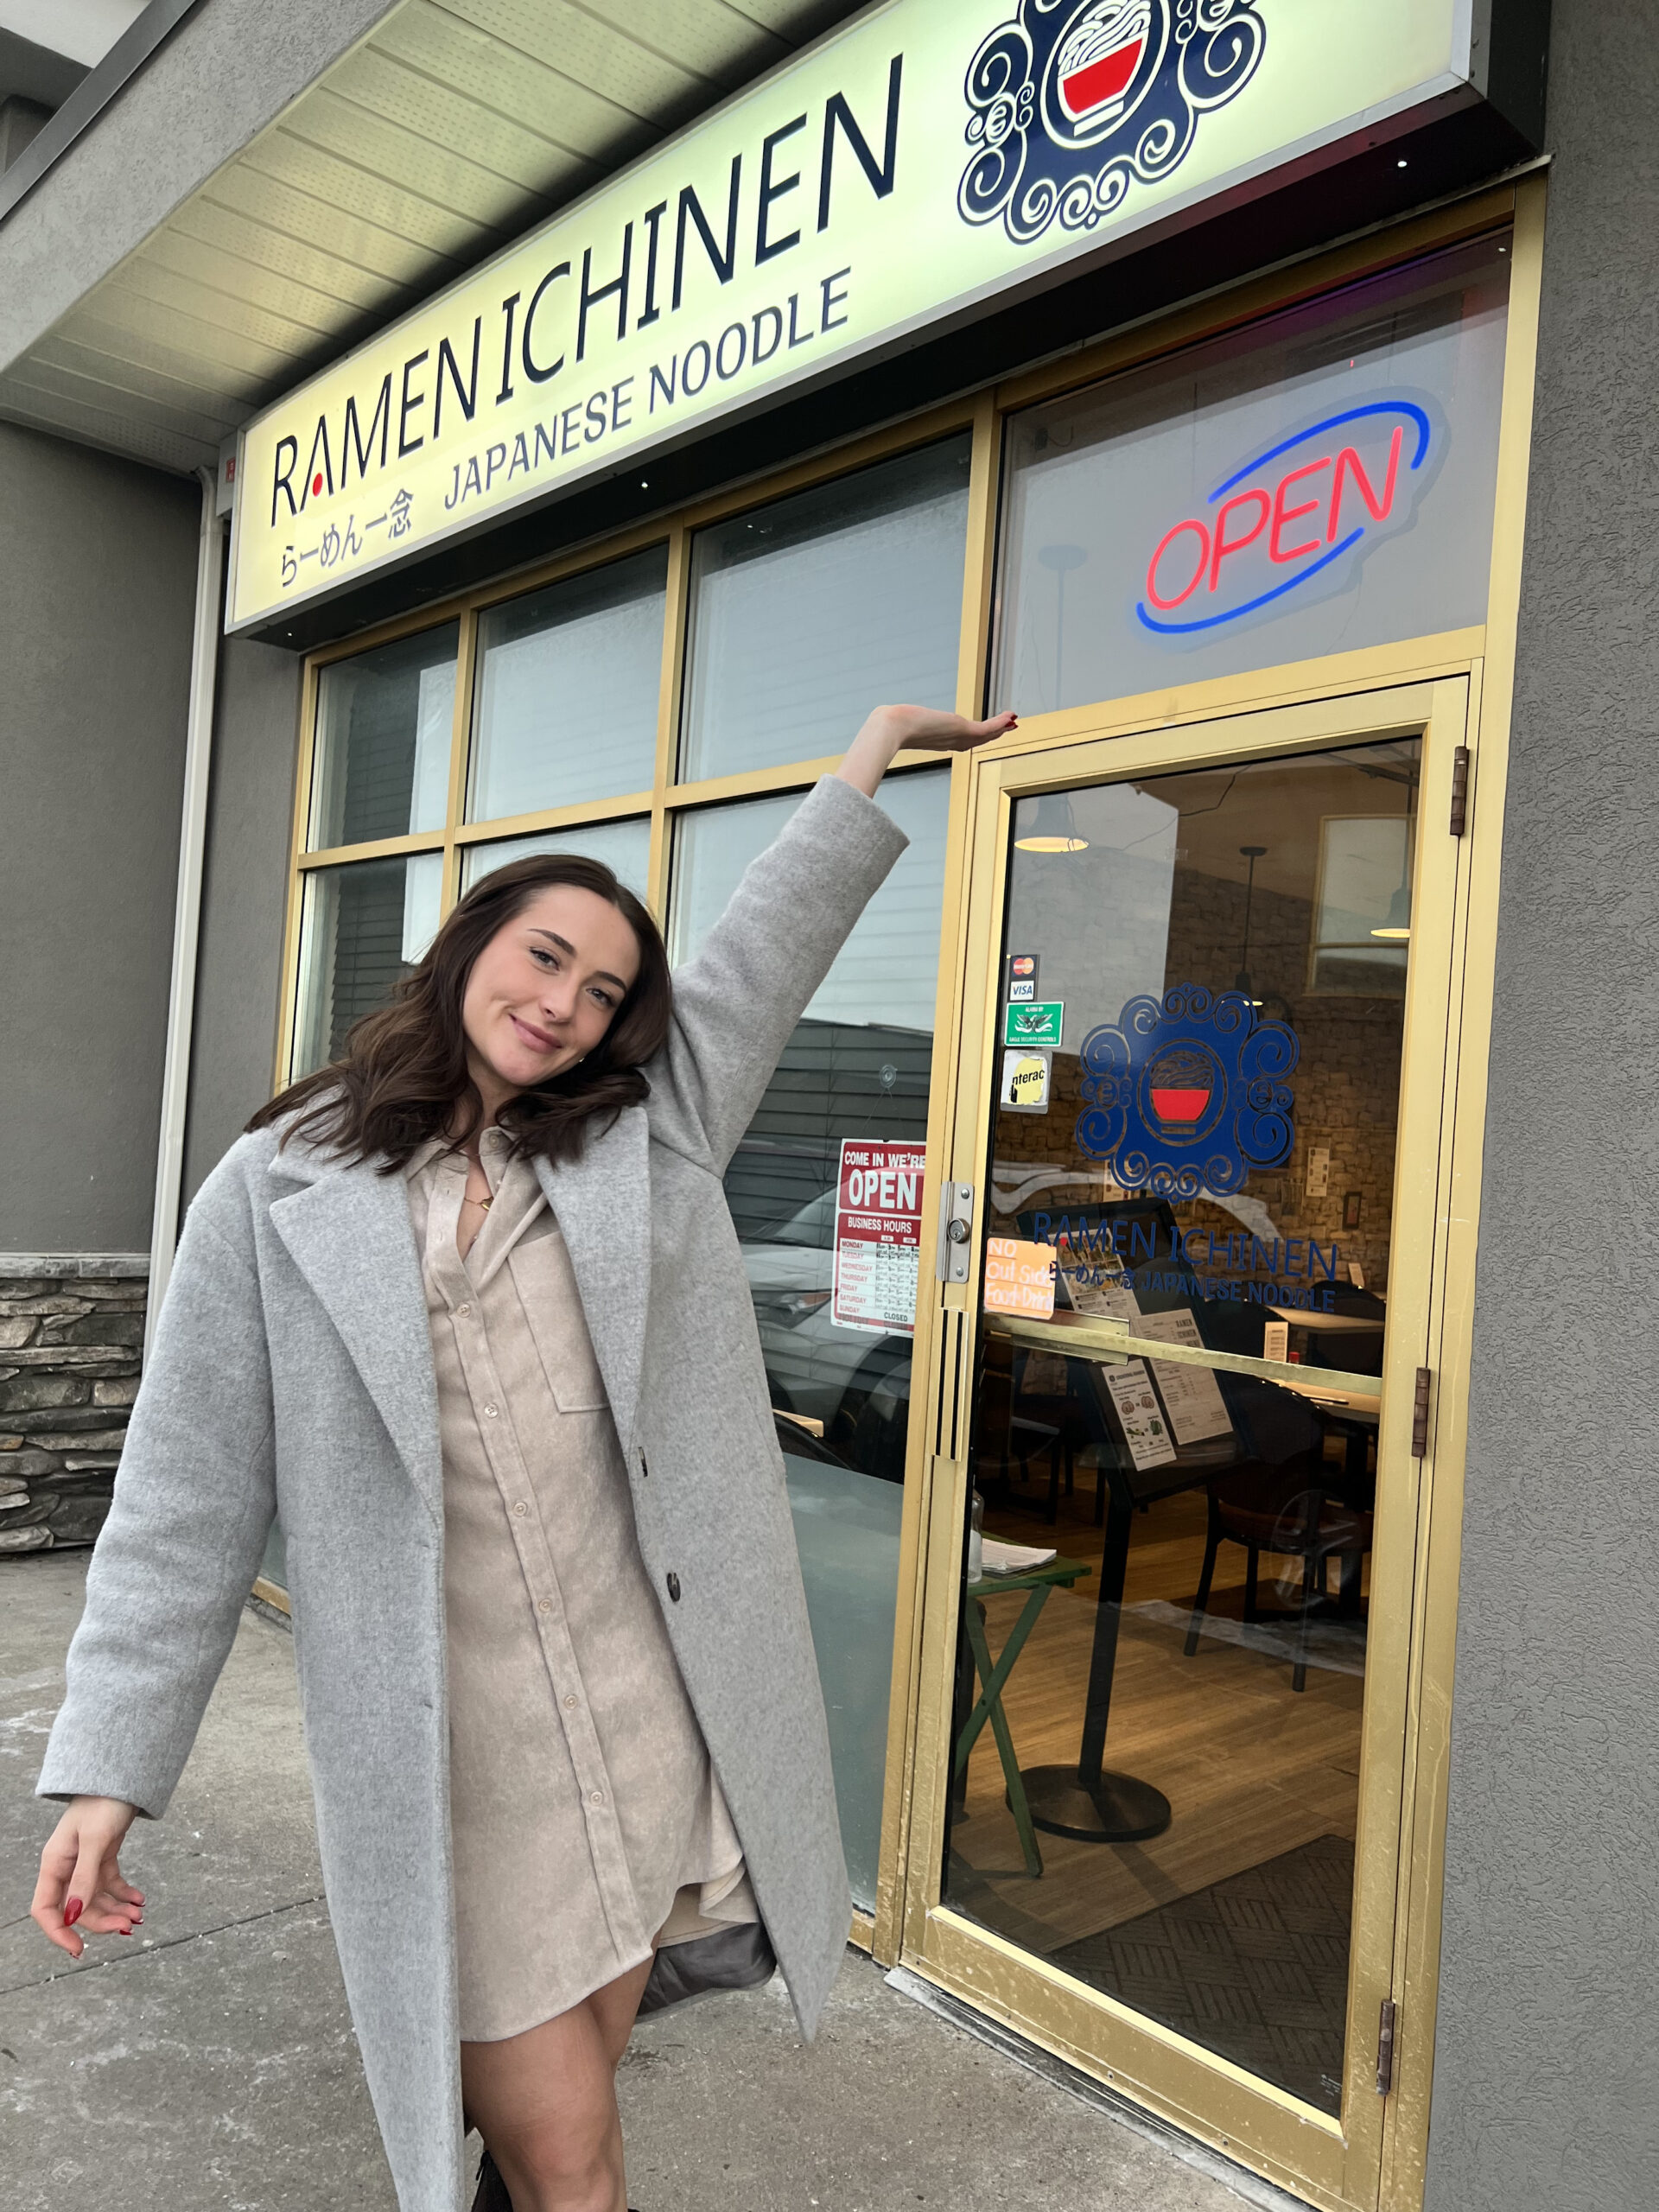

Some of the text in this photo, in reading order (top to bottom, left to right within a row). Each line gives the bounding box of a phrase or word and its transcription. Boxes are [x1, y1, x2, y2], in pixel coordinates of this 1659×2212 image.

[270, 51, 904, 529] RAMEN ICHINEN
[281, 265, 852, 588] らーめん一念 JAPANESE NOODLE
[1147, 425, 1404, 611] OPEN
[1013, 985, 1033, 995] VISA
[844, 1151, 926, 1169] COME IN WE'RE
[849, 1168, 917, 1211] OPEN
[848, 1216, 912, 1234] BUSINESS HOURS
[842, 1250, 865, 1260] TUESDAY
[988, 1239, 1017, 1258] NO
[1033, 1211, 1338, 1282] RAMEN ICHINEN
[842, 1262, 873, 1272] WEDNESDAY
[841, 1272, 868, 1282] THURSDAY
[840, 1283, 858, 1292] FRIDAY
[1141, 1271, 1243, 1302] JAPANESE
[1247, 1281, 1336, 1313] NOODLE
[840, 1294, 867, 1304] SATURDAY
[839, 1304, 908, 1322] SUNDAY CLOSED
